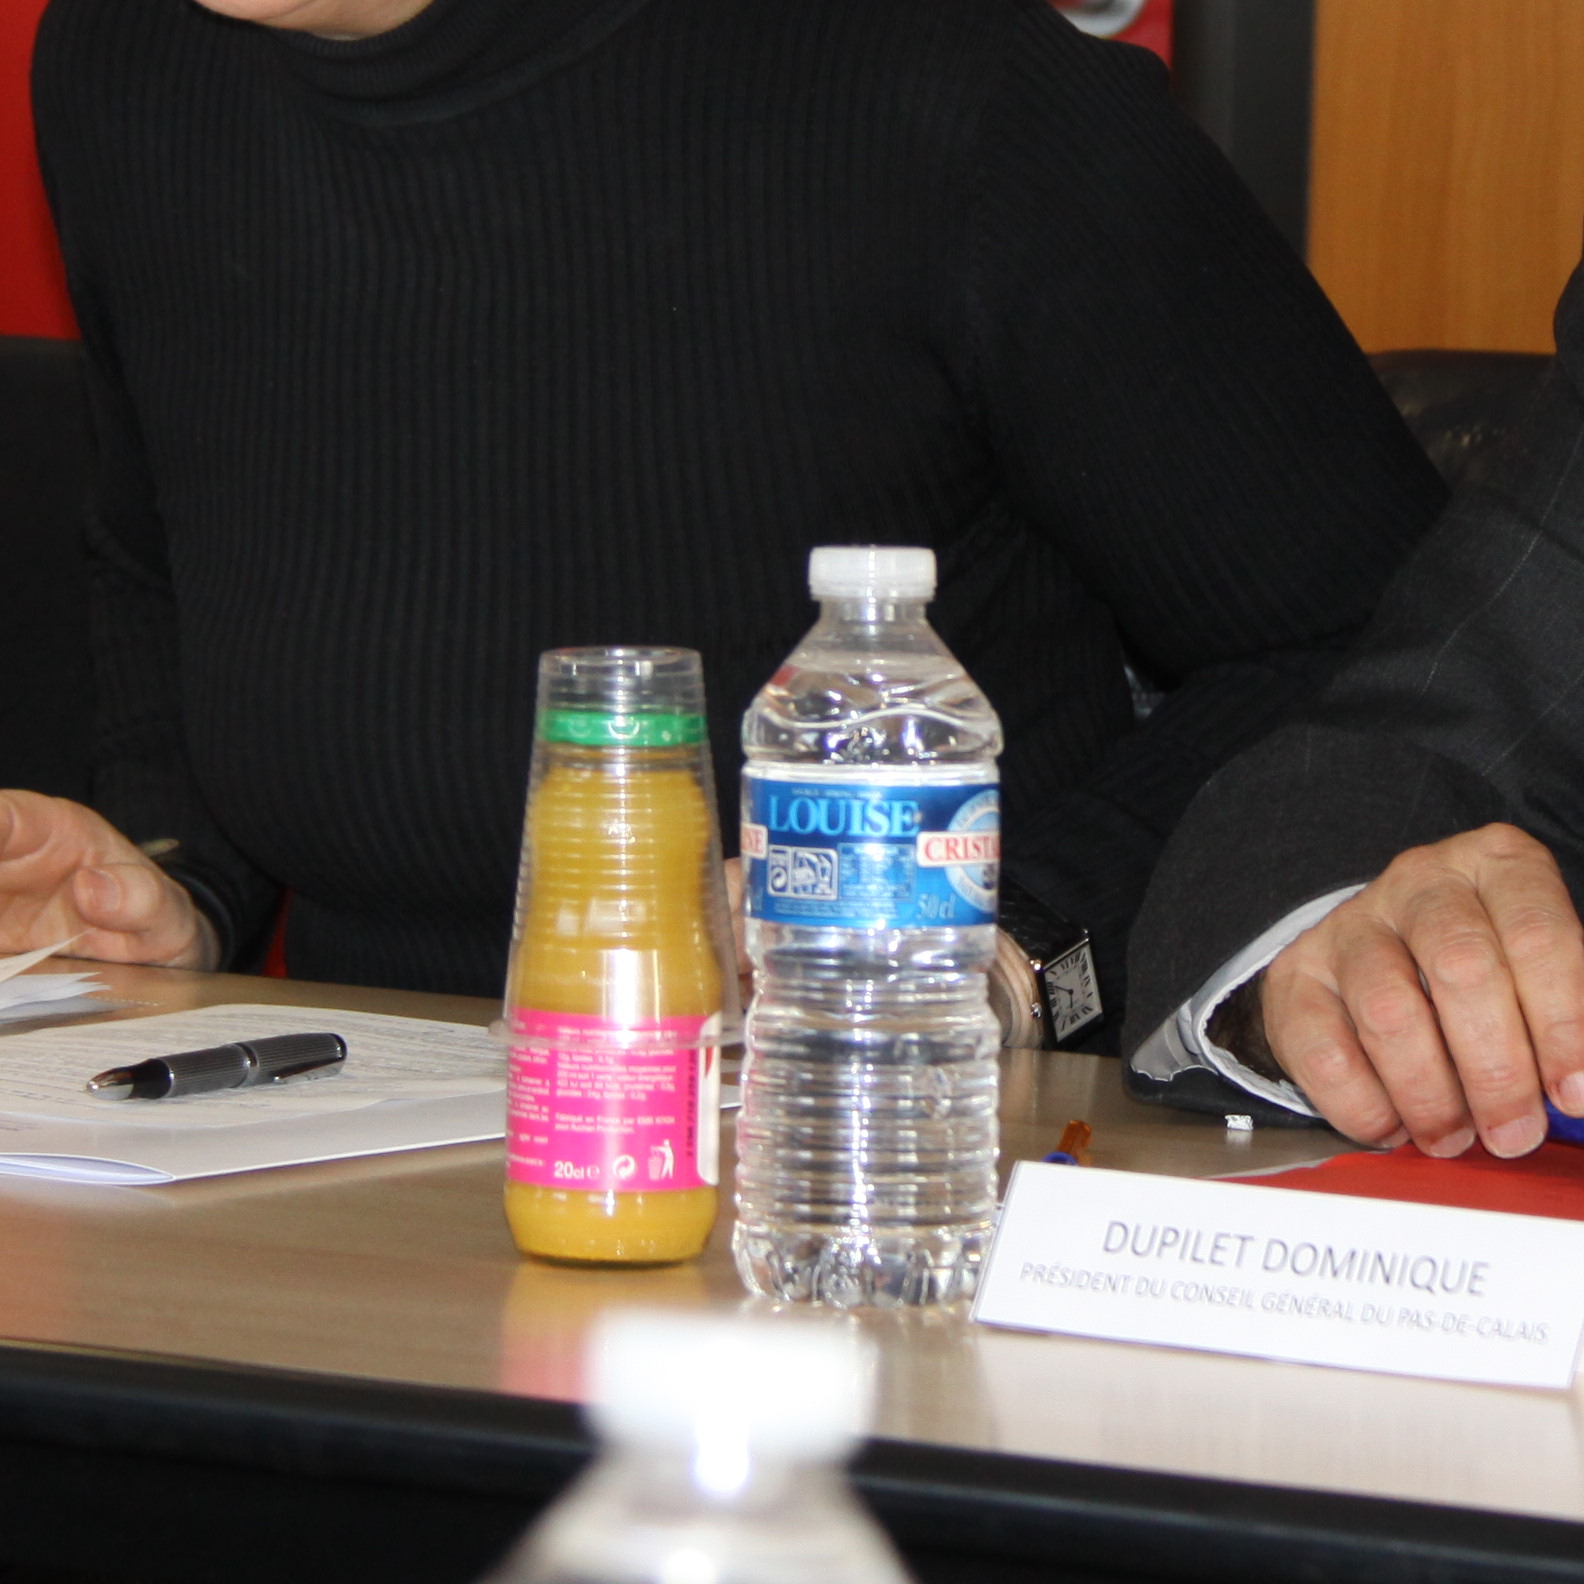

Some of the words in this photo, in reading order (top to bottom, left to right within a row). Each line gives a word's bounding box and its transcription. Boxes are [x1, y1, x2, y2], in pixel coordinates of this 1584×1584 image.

[768, 795, 921, 837] LOUISE
[553, 1159, 584, 1179] 20cl
[1103, 1219, 1256, 1268] DUPILET
[1263, 1237, 1490, 1297] DOMINIQUE
[1019, 1261, 1133, 1293] PRÉSIDENT
[1134, 1276, 1166, 1298] DU
[1170, 1280, 1255, 1309] CONSEIL
[1260, 1291, 1355, 1321] GÉNÉRAL
[1360, 1302, 1392, 1325] DU
